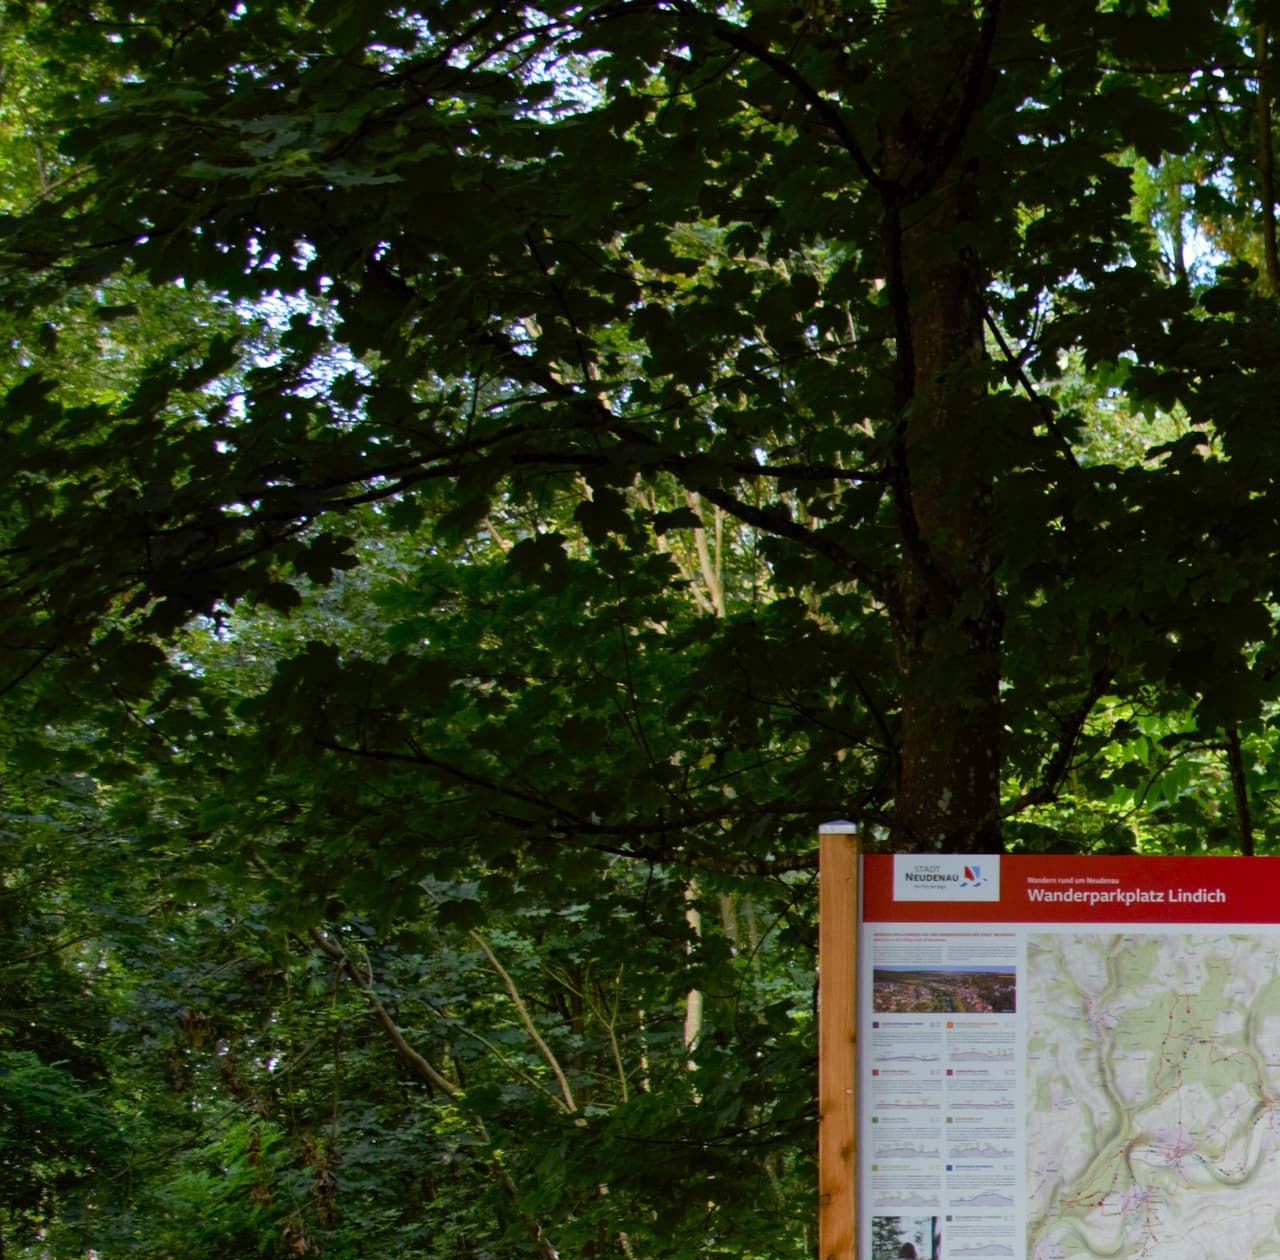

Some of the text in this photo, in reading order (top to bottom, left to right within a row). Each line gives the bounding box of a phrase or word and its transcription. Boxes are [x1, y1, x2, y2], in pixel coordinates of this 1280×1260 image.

[914, 865, 940, 873] STADT
[905, 873, 959, 881] NEUDENAU
[1027, 888, 1226, 906] Wanderparkplatz Lindich
